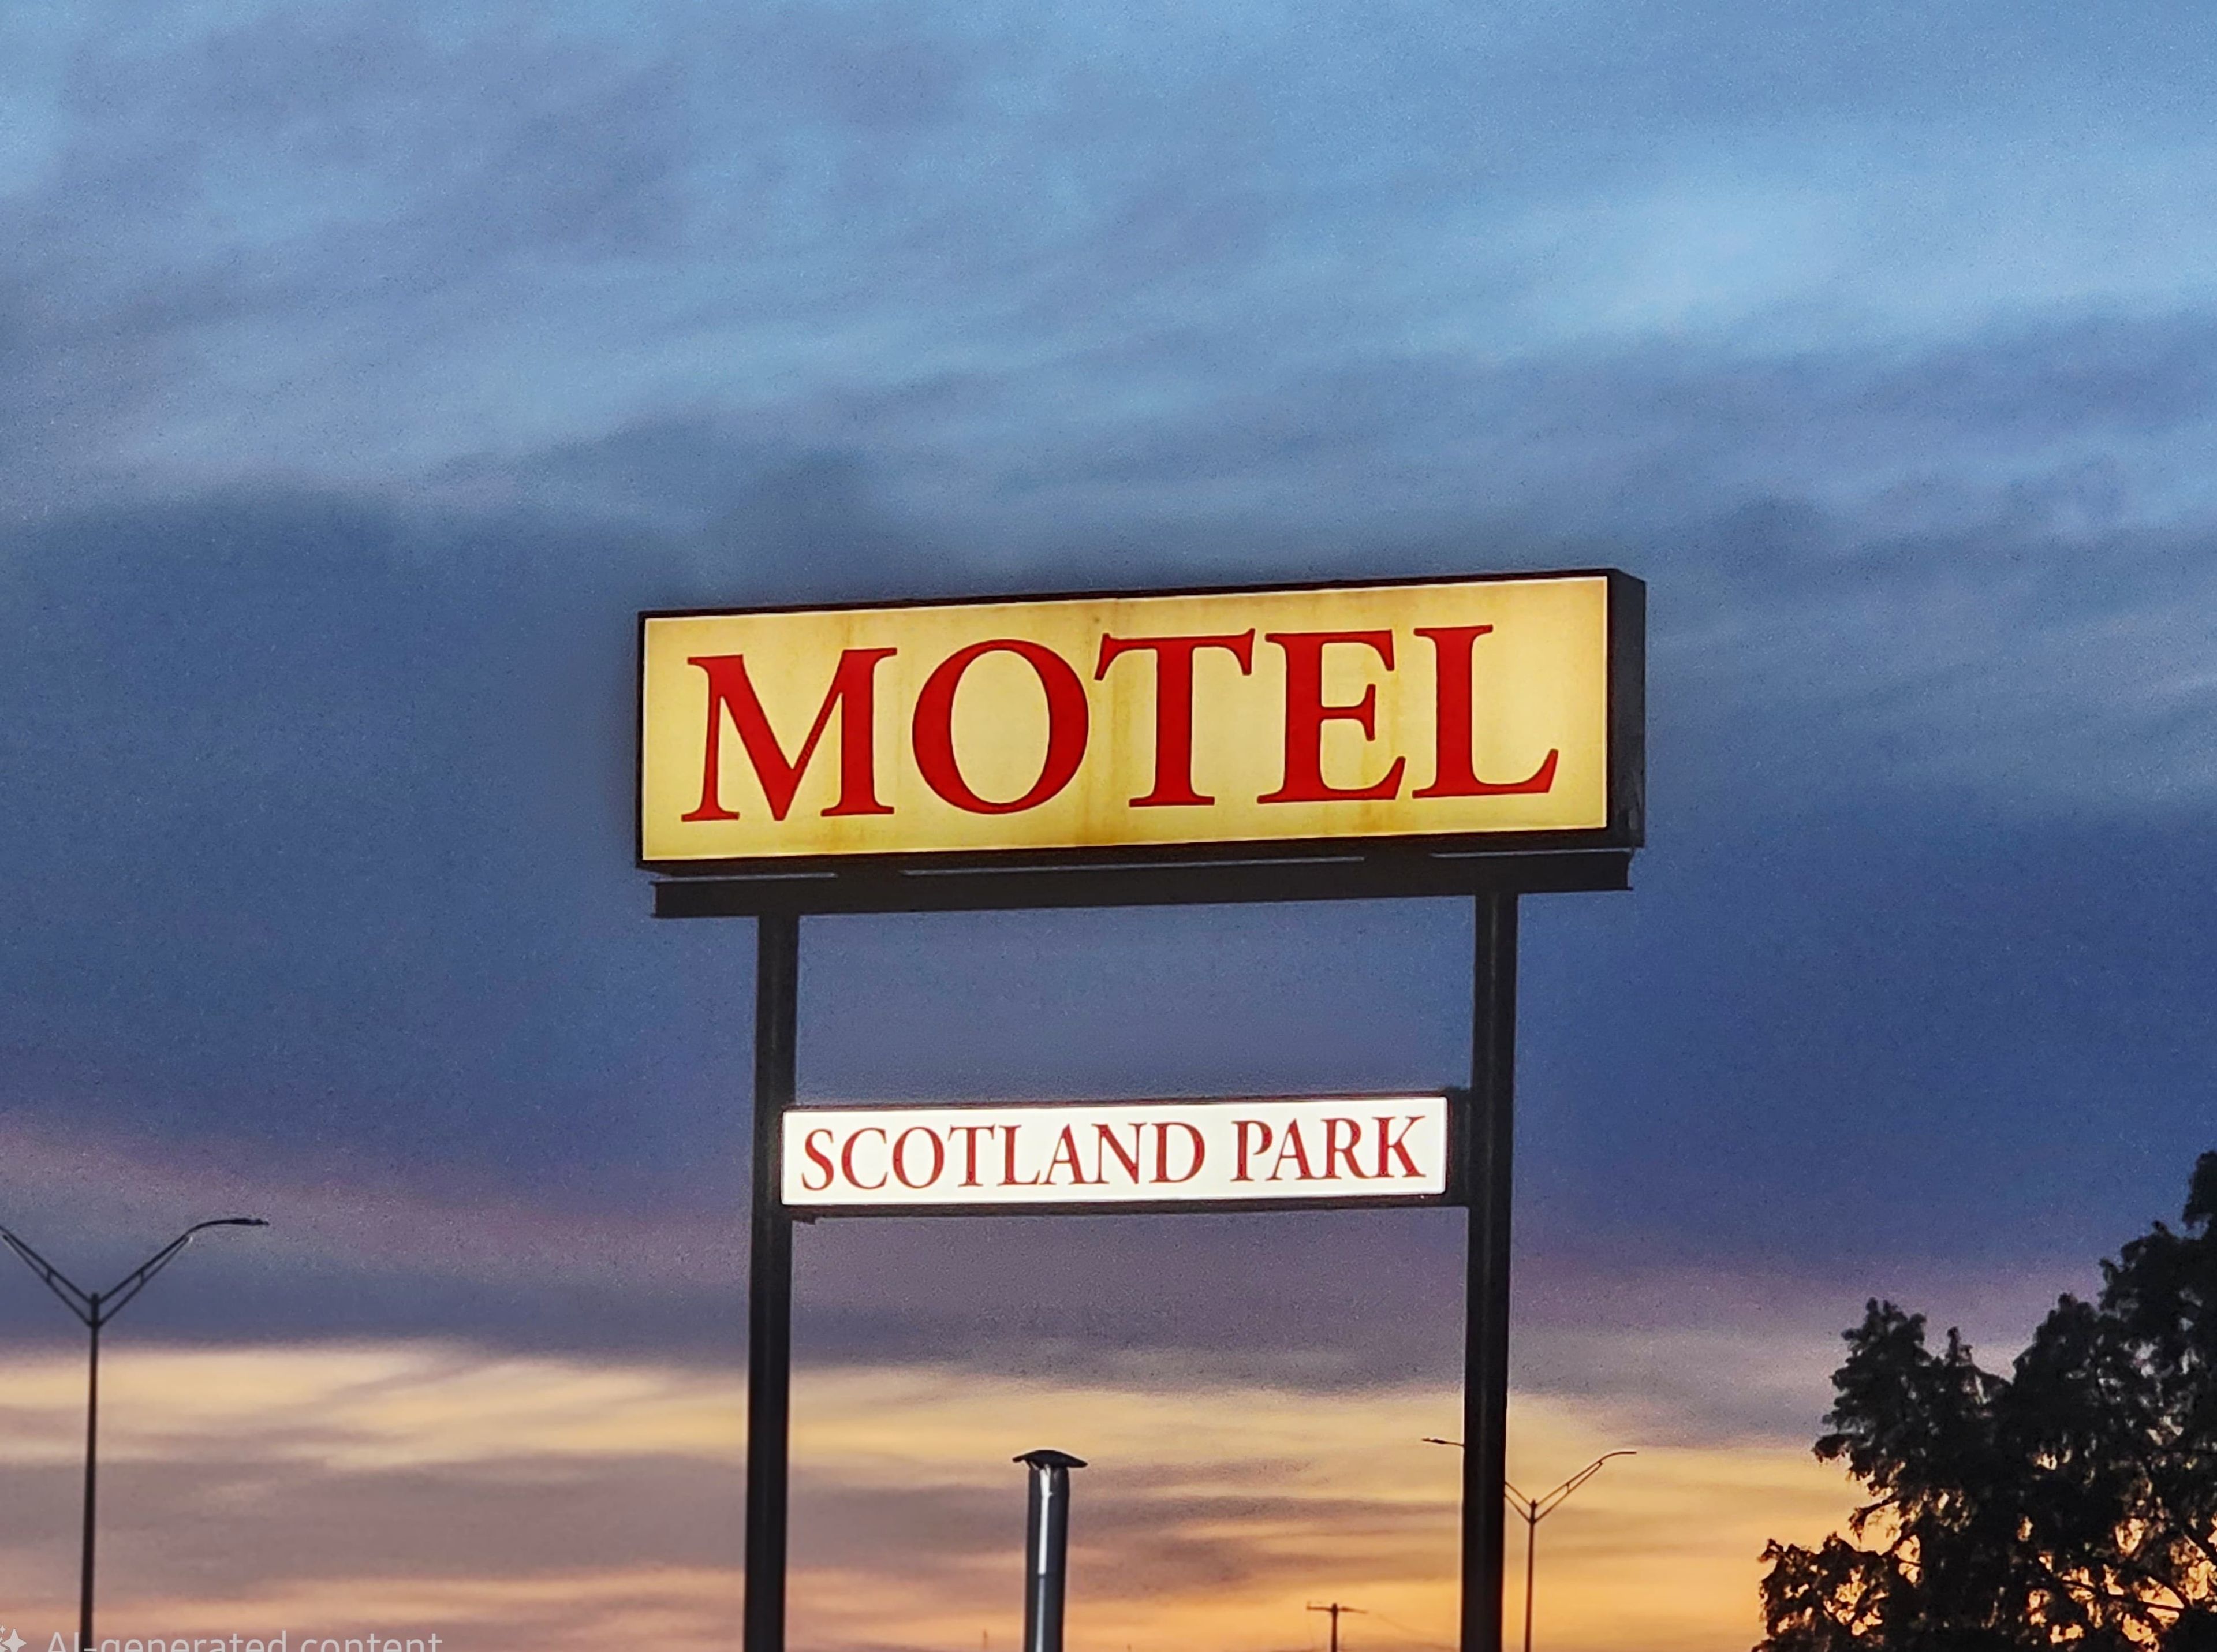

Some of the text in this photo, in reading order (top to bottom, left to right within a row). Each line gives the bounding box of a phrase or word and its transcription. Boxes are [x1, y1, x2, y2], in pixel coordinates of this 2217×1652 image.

[681, 624, 1559, 822] MOTEL
[801, 1115, 1426, 1191] SCOTLAND PARK
